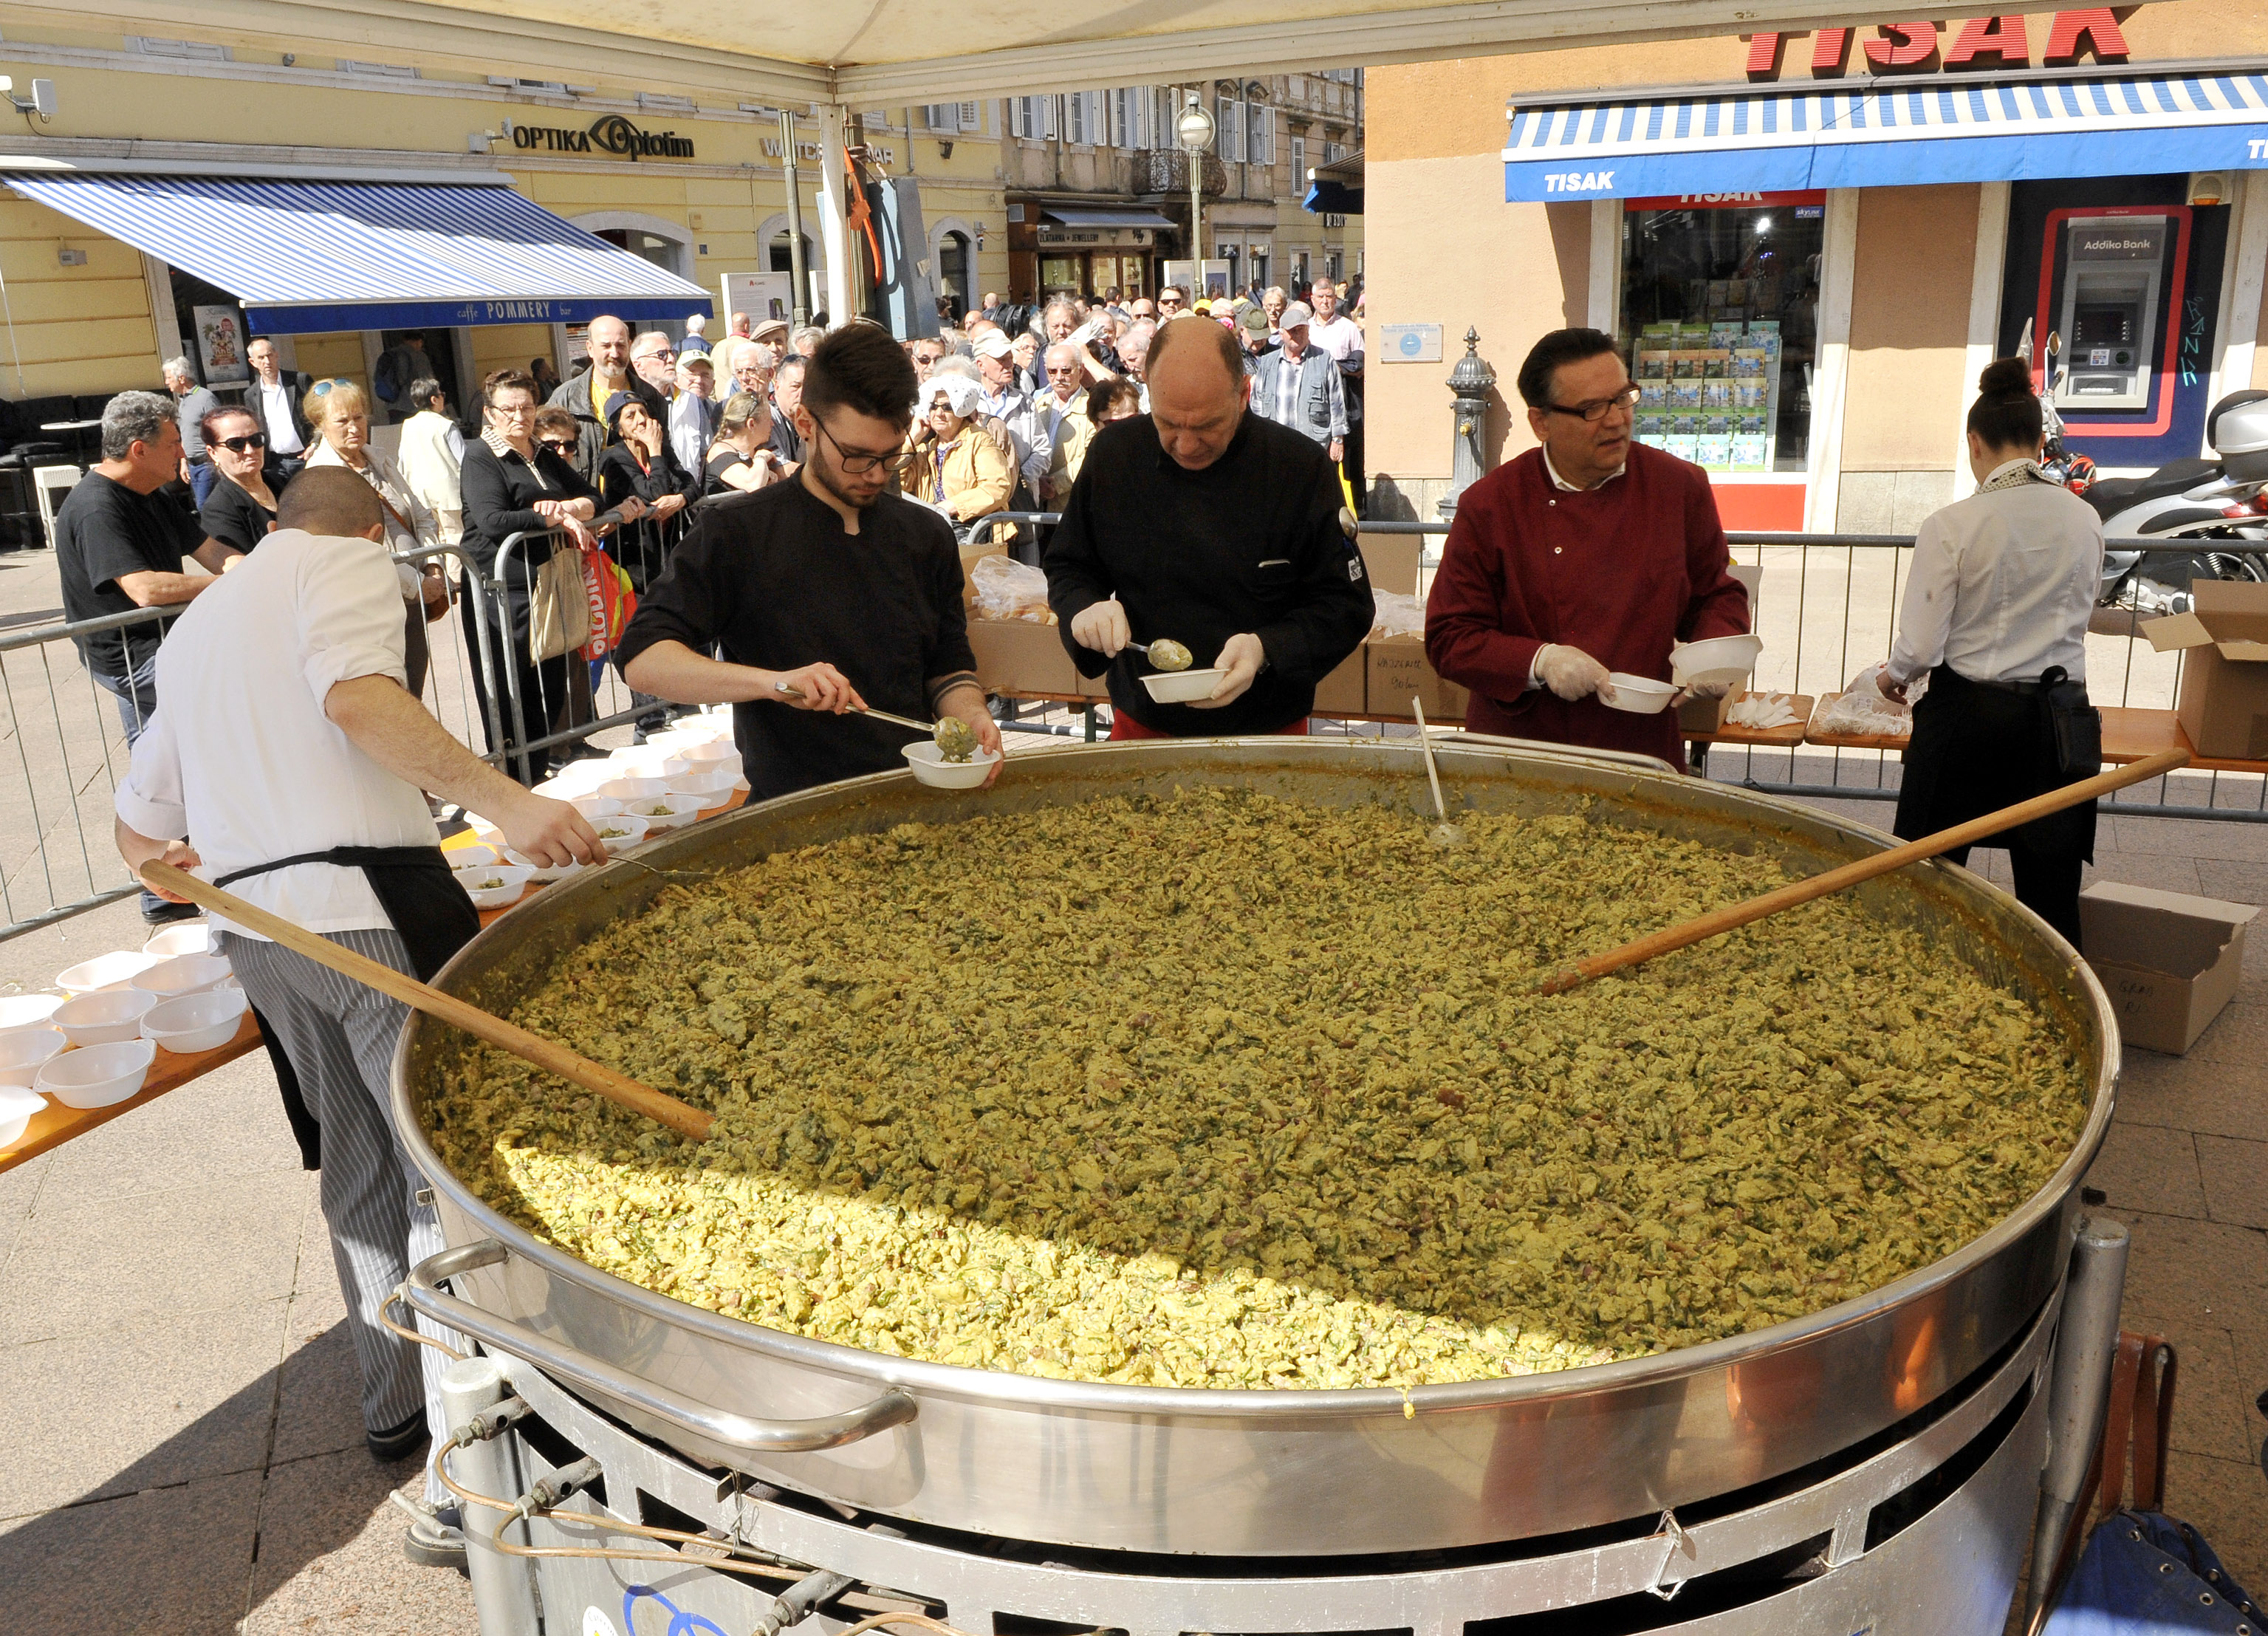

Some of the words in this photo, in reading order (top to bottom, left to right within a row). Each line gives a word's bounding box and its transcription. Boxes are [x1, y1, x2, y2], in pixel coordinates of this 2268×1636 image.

[513, 126, 592, 152] OPTIKA
[607, 117, 695, 162] Optotim
[761, 137, 823, 160] WTC
[1544, 171, 1615, 192] TISAK
[2084, 240, 2122, 250] Addiko
[2123, 239, 2151, 249] Bank
[457, 304, 479, 322] caffe
[487, 301, 550, 318] POMMERY
[559, 302, 572, 315] bar
[584, 563, 607, 655] PLODIN
